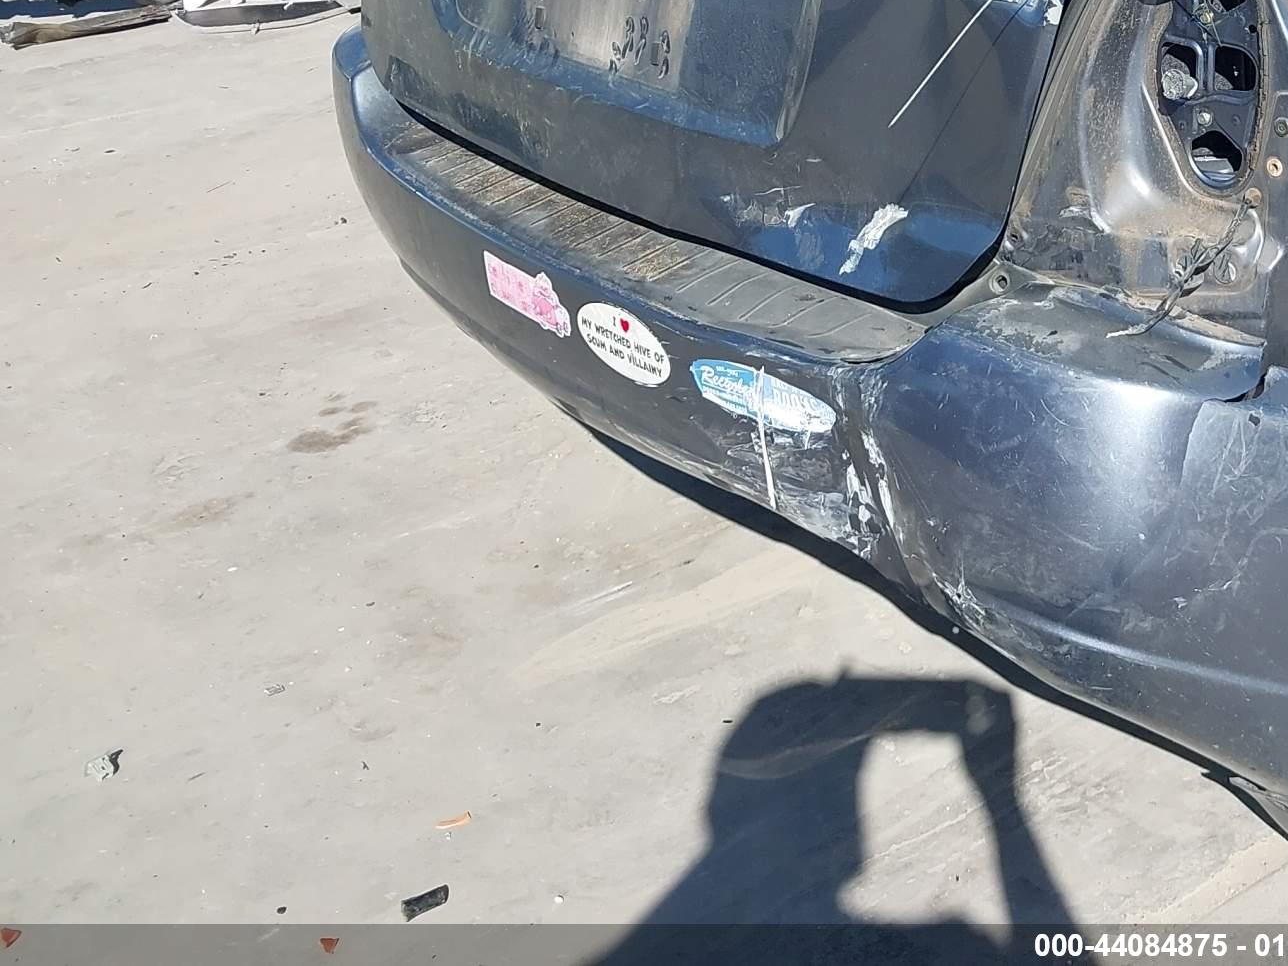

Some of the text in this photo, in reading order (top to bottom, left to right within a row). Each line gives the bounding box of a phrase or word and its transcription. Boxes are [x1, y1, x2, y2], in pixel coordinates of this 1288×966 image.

[581, 316, 665, 364] MY WRETCHED HIVE OF
[586, 333, 662, 378] SCUM AND VILLAINY
